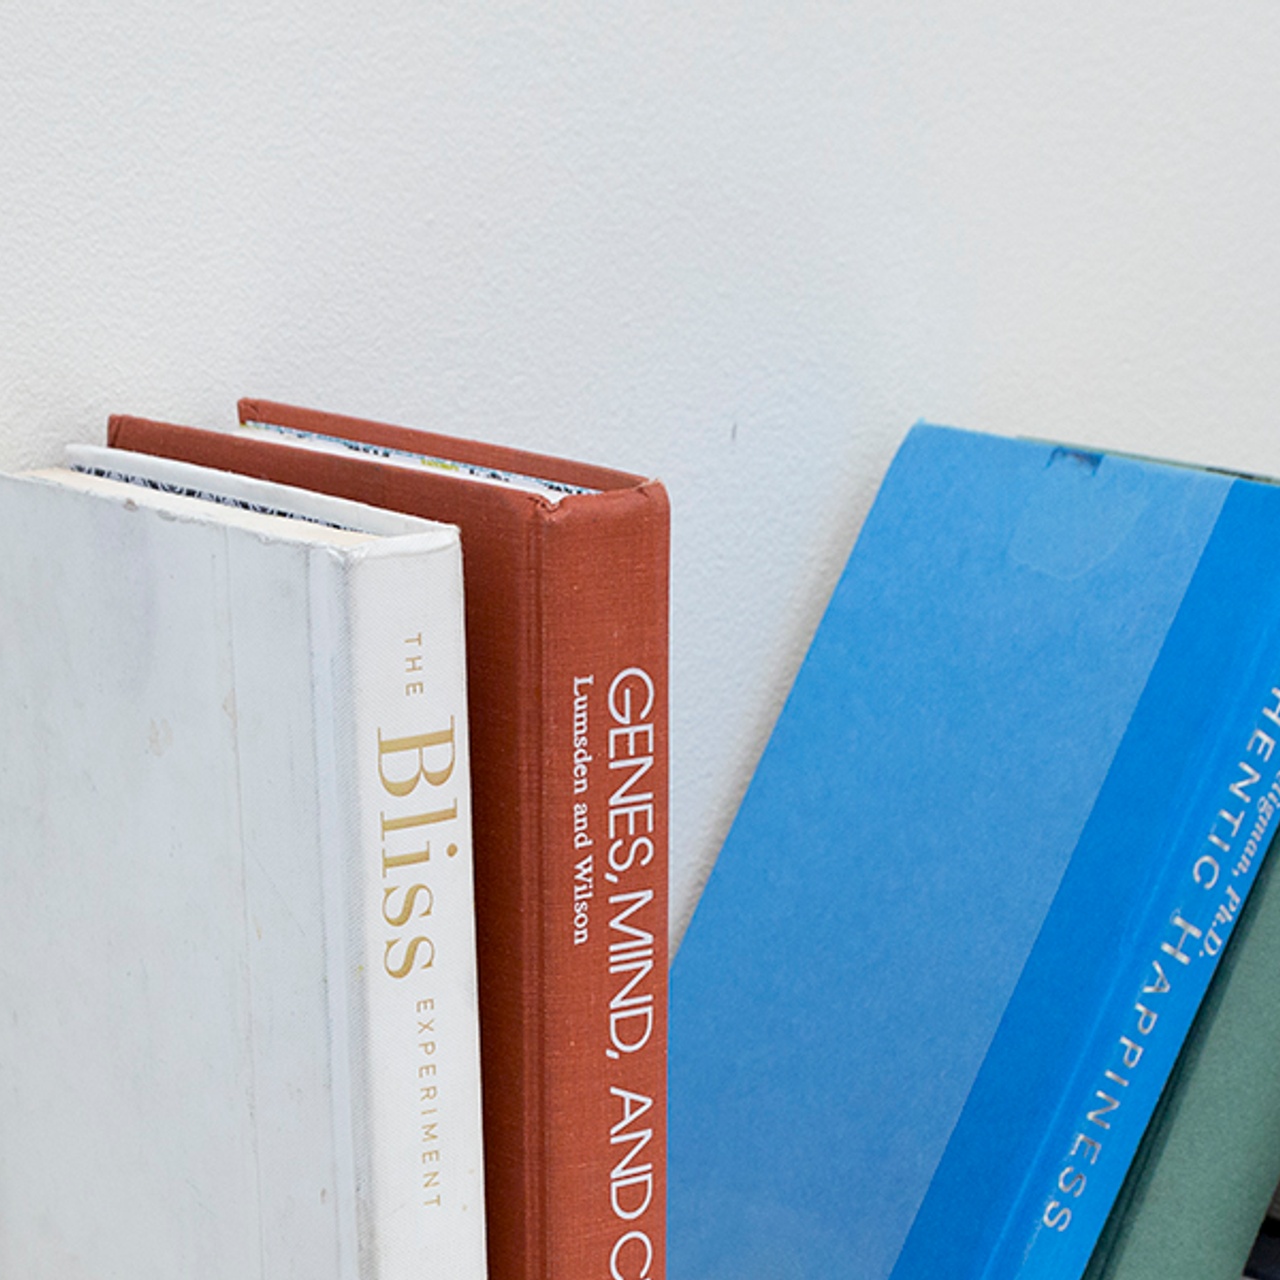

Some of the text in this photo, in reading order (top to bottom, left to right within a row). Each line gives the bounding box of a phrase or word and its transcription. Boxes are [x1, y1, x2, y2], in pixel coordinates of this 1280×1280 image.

[573, 674, 596, 945] Lumsden and Wilson
[604, 667, 656, 883] GENES,
[377, 631, 460, 1208] THE Bliss EXPERIMENT
[605, 889, 655, 1060] MIND,
[1198, 884, 1241, 957] Ph.D.
[608, 1086, 655, 1220] AND
[1042, 915, 1203, 1233] HAPPINESS
